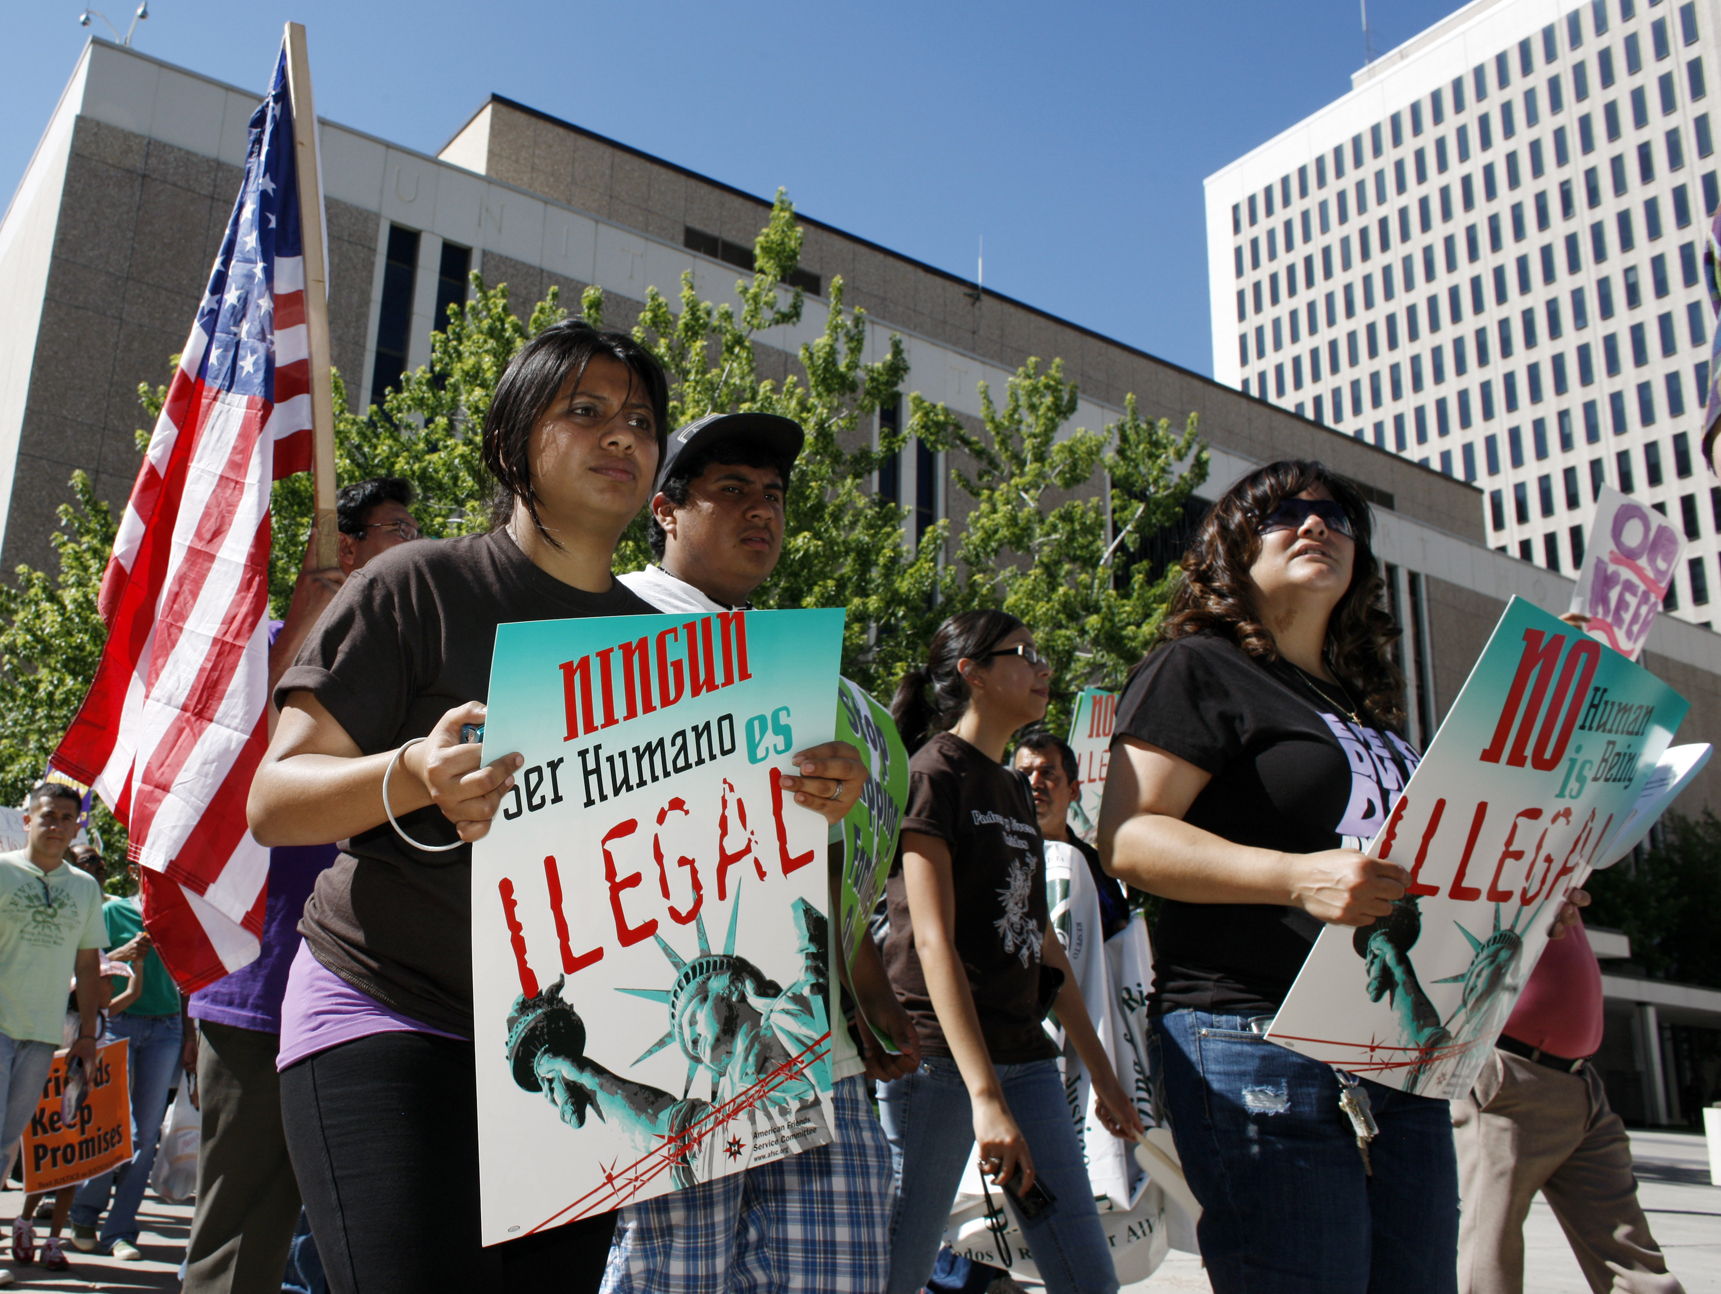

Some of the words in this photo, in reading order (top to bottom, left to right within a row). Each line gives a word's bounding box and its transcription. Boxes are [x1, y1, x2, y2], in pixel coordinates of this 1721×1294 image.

[558, 611, 752, 742] NINGUN
[1479, 627, 1600, 772] NO
[1578, 686, 1656, 737] Human
[1088, 694, 1116, 738] NO
[577, 713, 737, 808] Humano
[745, 706, 793, 765] es
[1555, 744, 1593, 800] is
[498, 767, 815, 999] ILEGAL
[43, 1057, 110, 1099] rids
[33, 1124, 122, 1172] Promises
[753, 1124, 785, 1140] American
[787, 1116, 811, 1130] Friends
[753, 1138, 779, 1152] Service
[780, 1127, 817, 1143] Committee
[1126, 1218, 1153, 1243] All
